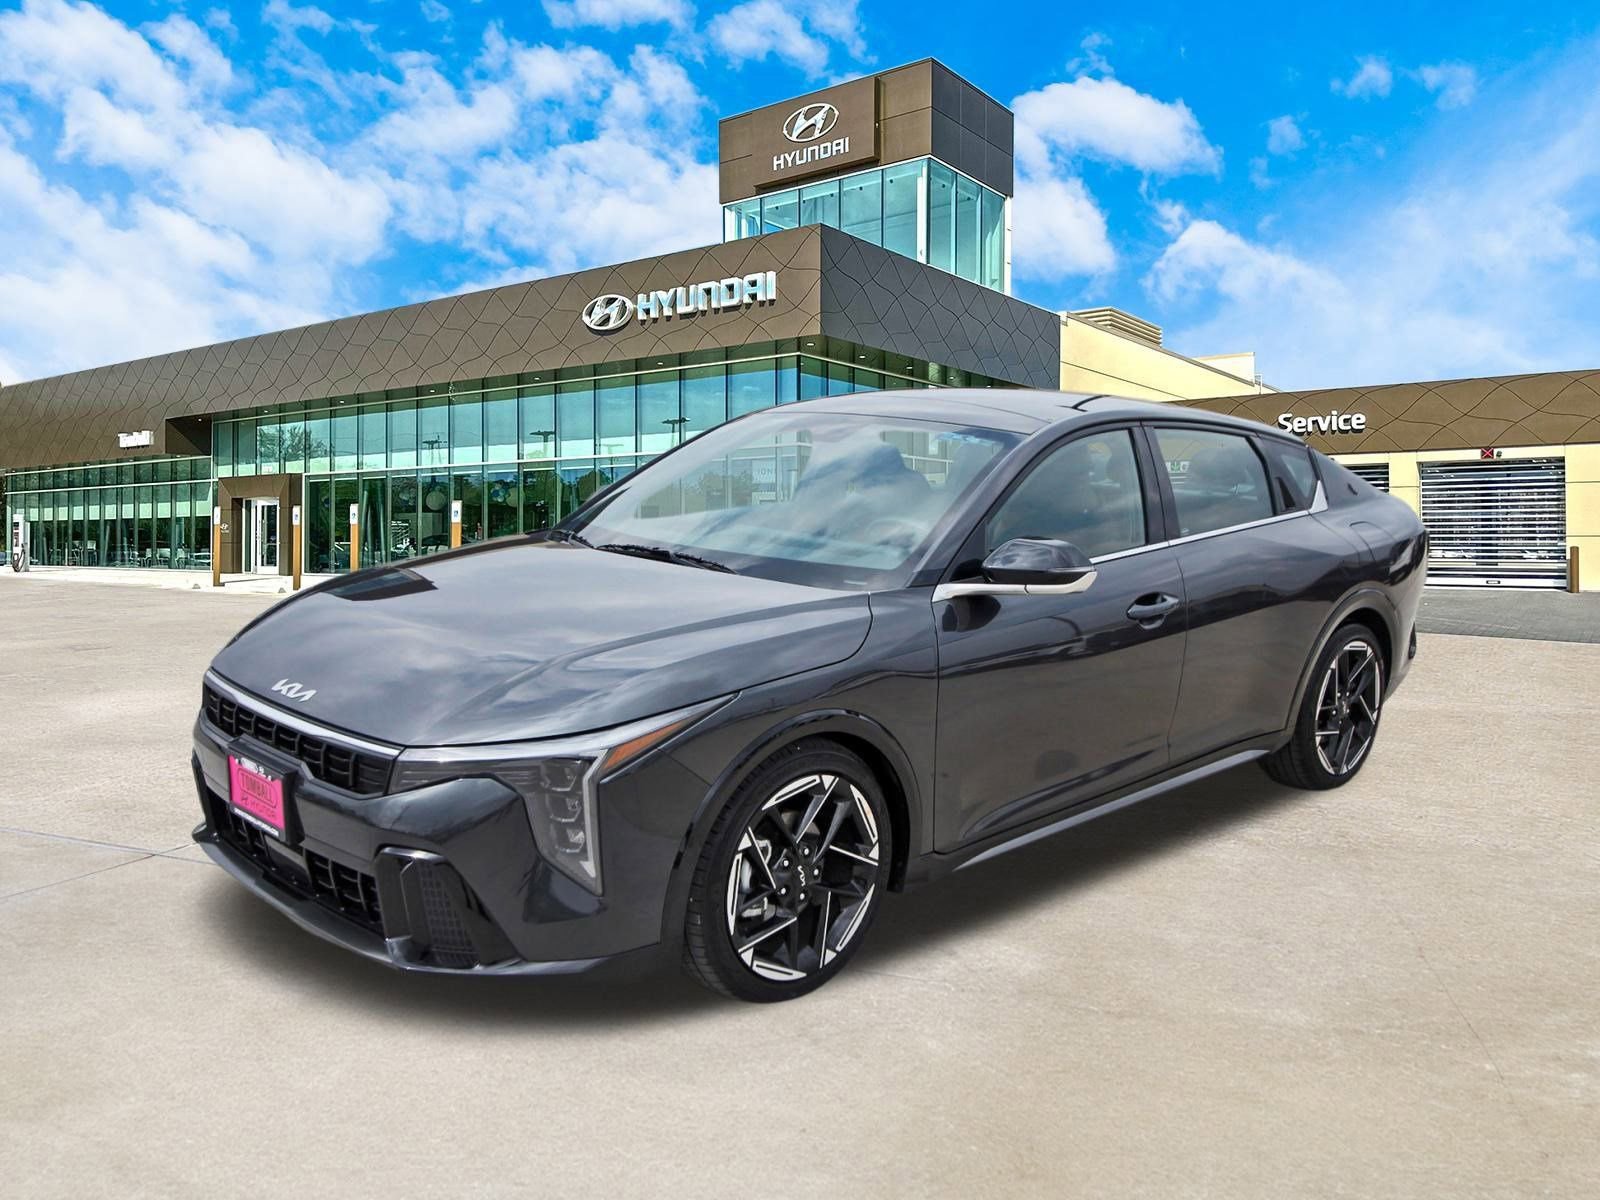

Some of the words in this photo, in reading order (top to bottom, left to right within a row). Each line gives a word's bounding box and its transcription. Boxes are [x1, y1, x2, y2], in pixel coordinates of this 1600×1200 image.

[773, 137, 849, 171] HYUNDAI
[637, 270, 777, 321] HYUNDAI
[1278, 410, 1366, 433] Service
